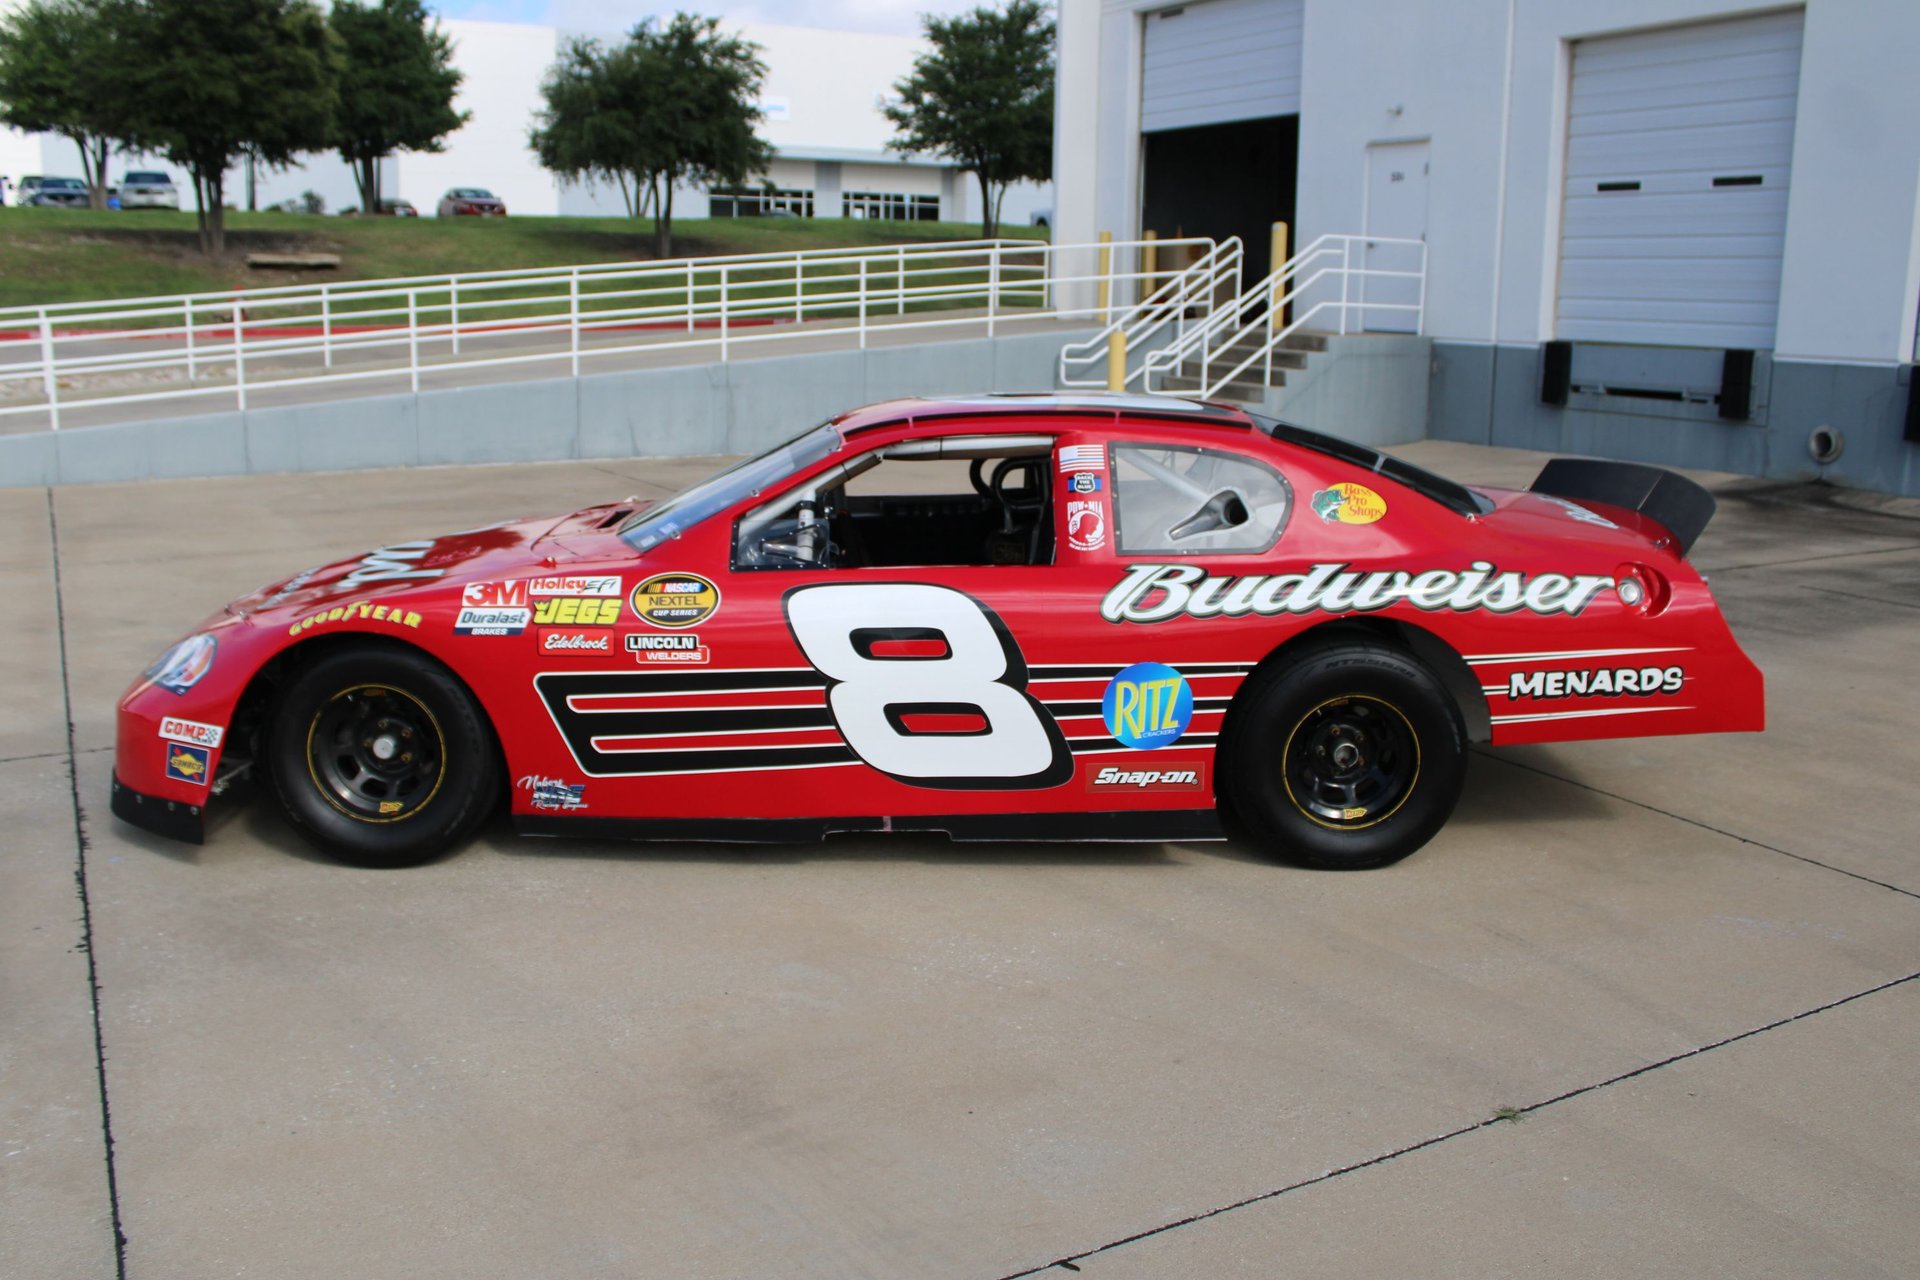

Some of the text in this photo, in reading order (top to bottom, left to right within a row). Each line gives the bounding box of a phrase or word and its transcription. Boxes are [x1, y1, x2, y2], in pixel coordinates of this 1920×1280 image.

[1344, 483, 1373, 496] Bass
[1347, 495, 1368, 505] Pro
[1349, 505, 1384, 519] Shops
[464, 580, 528, 605] 3M
[533, 576, 586, 594] Holley
[664, 582, 701, 593] NASCAR
[1100, 560, 1616, 625] Budweiser
[648, 595, 702, 607] NEXTEL
[289, 600, 422, 636] GOODYEAR
[461, 610, 526, 624] Duralast
[533, 597, 623, 625] JEGS
[670, 608, 698, 616] SERIES
[471, 627, 508, 635] BRAKES
[544, 634, 608, 650] Edelbrock
[629, 637, 694, 649] LINCOLN
[646, 651, 702, 661] WELDERS
[781, 581, 1075, 791] 8
[1508, 666, 1684, 700] MENARDS
[1114, 677, 1182, 739] RITZ
[165, 720, 206, 739] COMP
[1142, 728, 1176, 738] CRACKERS
[1093, 767, 1196, 787] Snap-on
